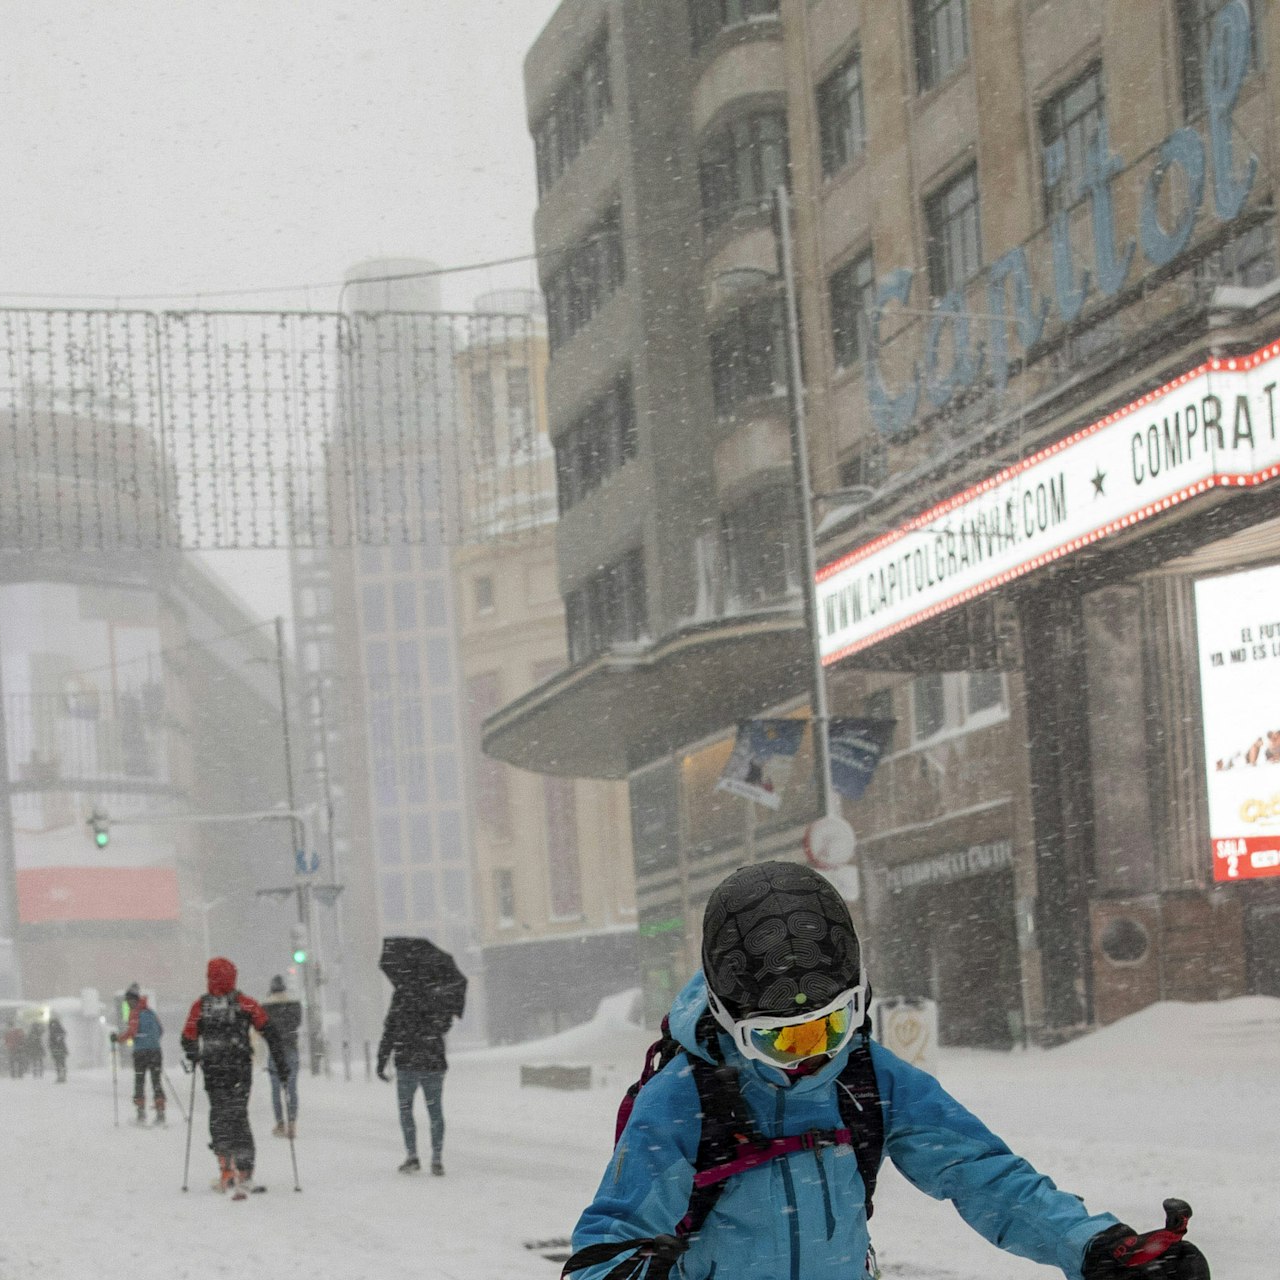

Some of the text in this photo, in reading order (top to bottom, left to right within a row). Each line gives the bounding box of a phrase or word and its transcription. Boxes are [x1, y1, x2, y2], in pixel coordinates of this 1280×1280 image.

[866, 0, 1260, 437] Capitol
[822, 472, 1068, 636] WWW.CAPITOLGRANVIA.COM
[1130, 394, 1256, 486] COMPRA
[1241, 627, 1253, 644] EL
[1252, 645, 1267, 661] ES
[1216, 838, 1248, 859] SALA
[1227, 855, 1239, 878] 2
